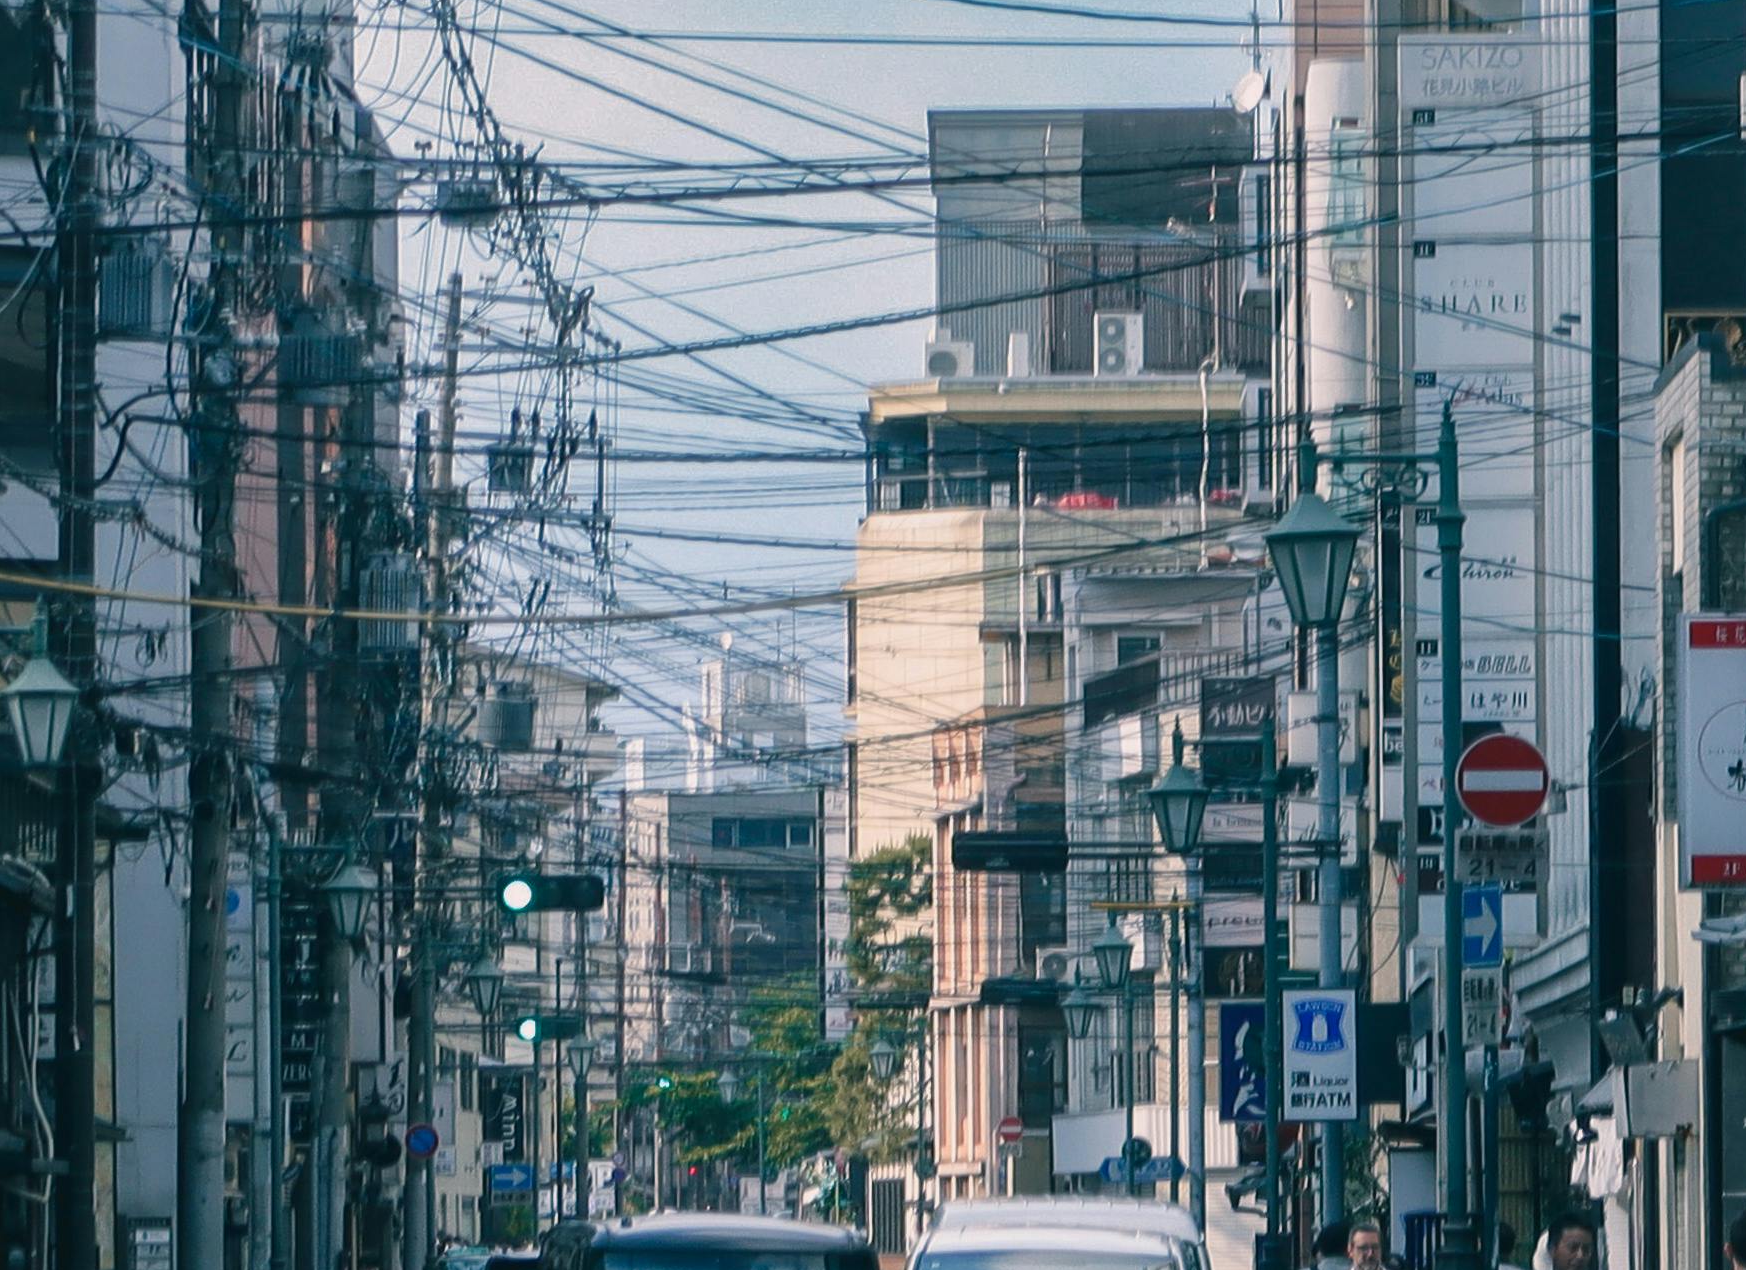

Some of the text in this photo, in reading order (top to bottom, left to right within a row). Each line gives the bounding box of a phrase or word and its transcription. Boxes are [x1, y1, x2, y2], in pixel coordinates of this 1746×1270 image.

[1422, 45, 1523, 71] SAKIZO
[1421, 295, 1528, 313] SHARE
[1469, 691, 1528, 710] はや川
